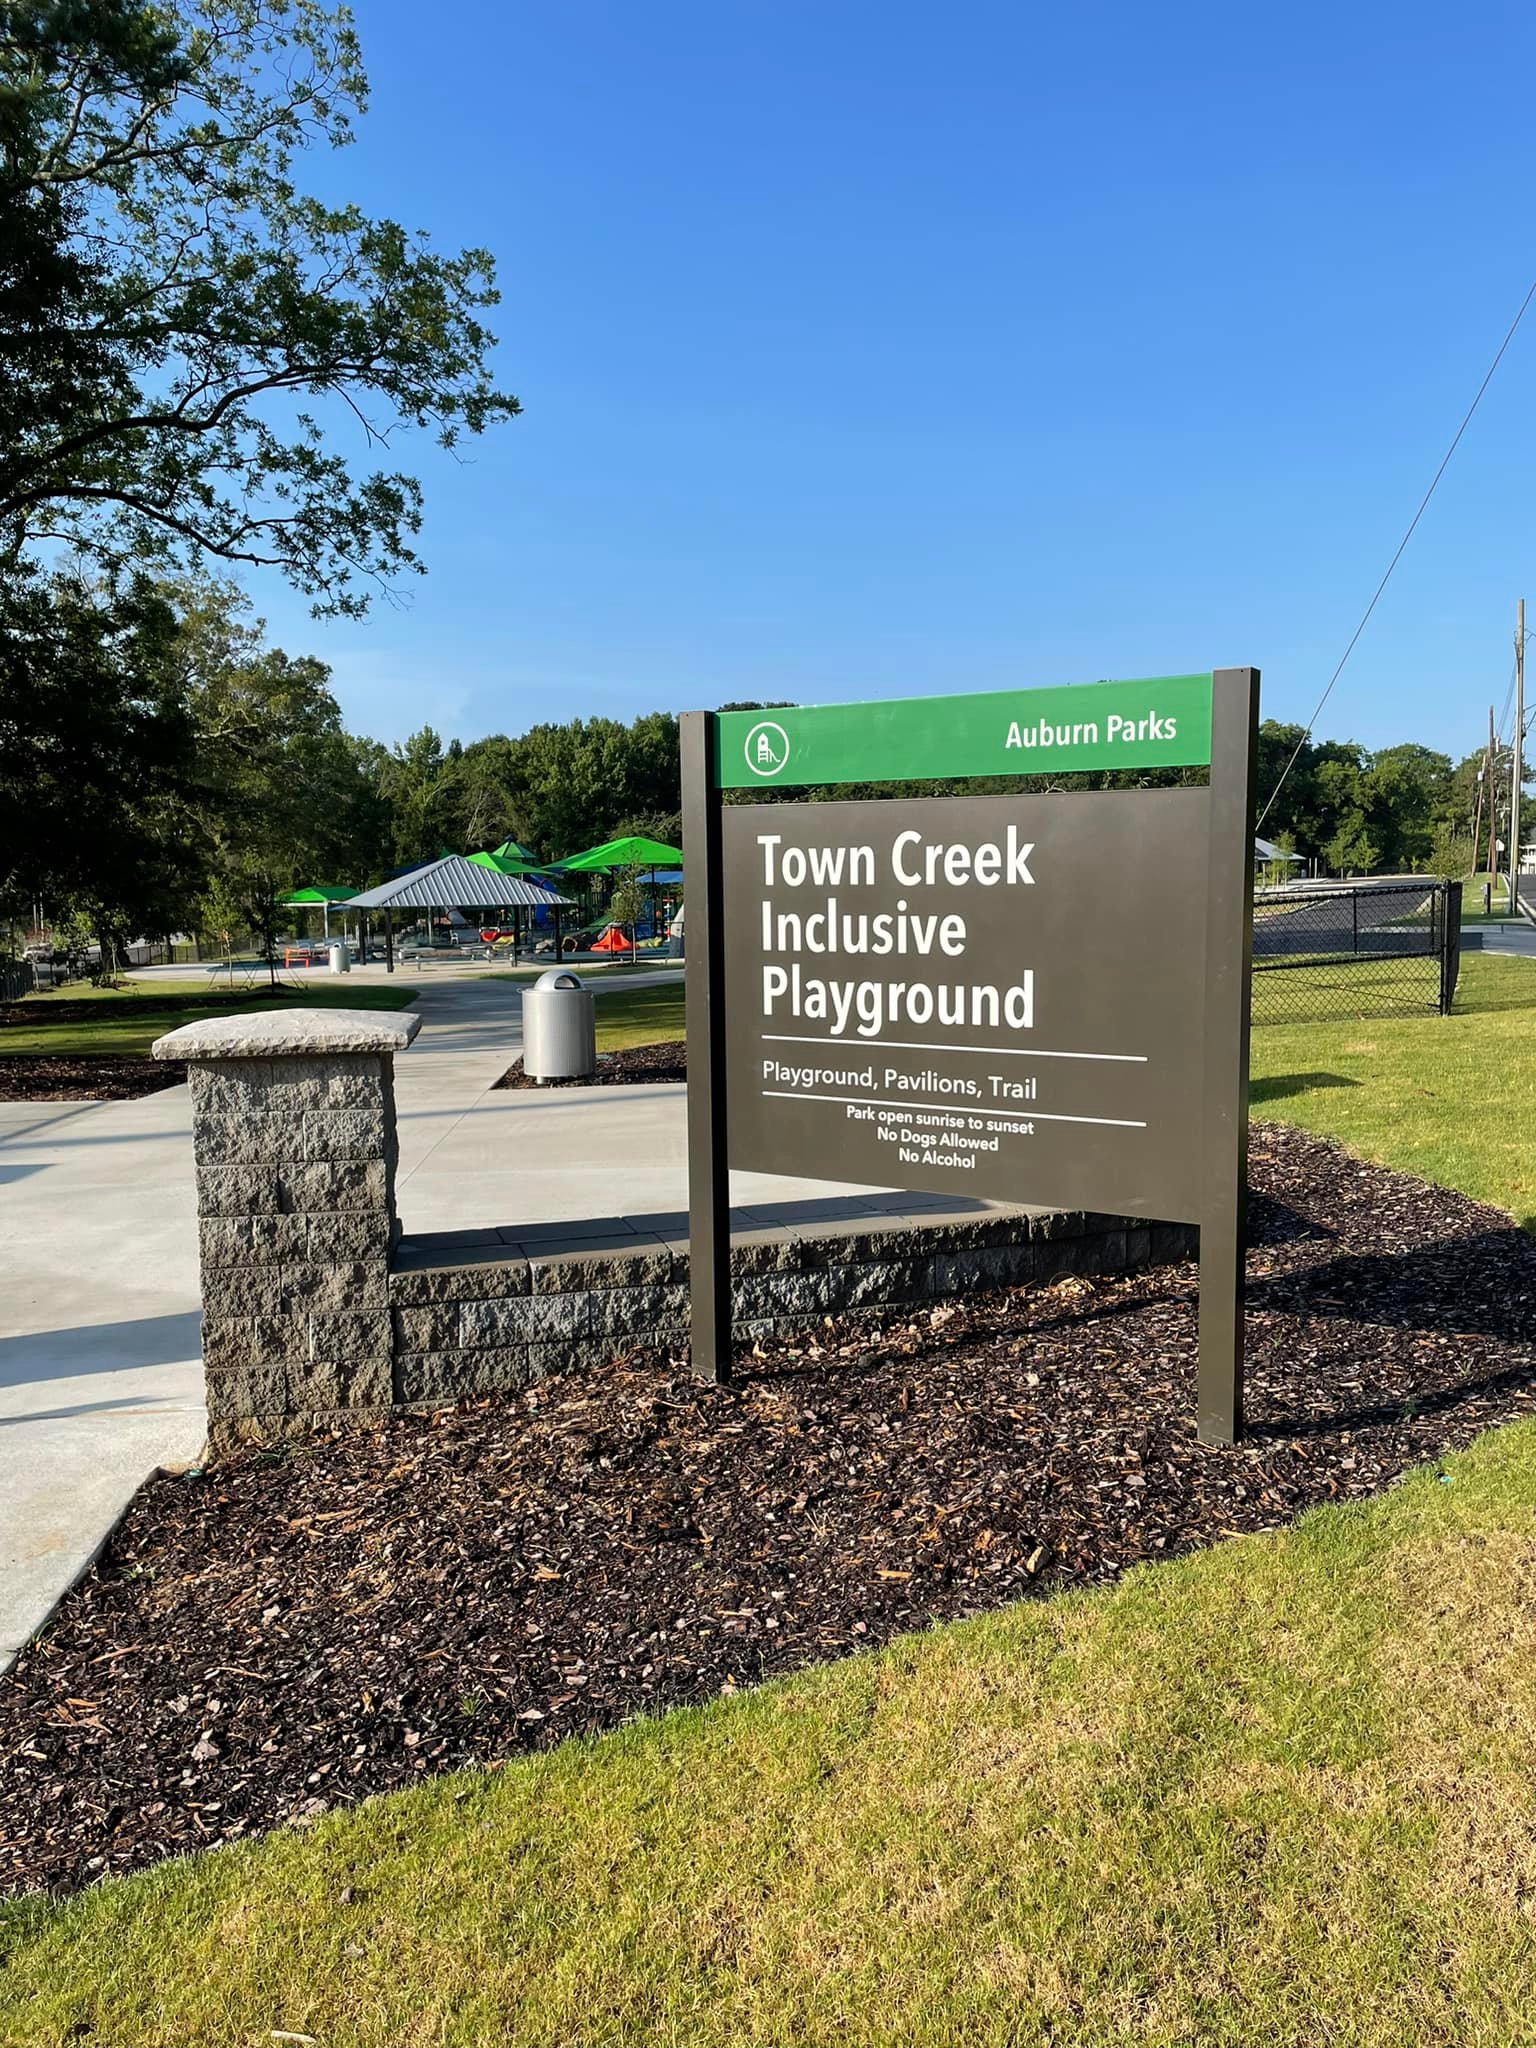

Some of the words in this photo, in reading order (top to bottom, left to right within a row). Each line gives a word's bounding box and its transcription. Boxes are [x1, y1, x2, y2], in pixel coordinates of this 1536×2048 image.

[1005, 717, 1098, 749] Auburn
[1106, 710, 1177, 743] Parks
[756, 834, 875, 887] Town
[891, 824, 1036, 887] Creek
[761, 897, 967, 957] Inclusive
[762, 963, 1034, 1037] Playground
[763, 1060, 879, 1091] Playground,
[884, 1068, 983, 1099] Pavilions,
[987, 1075, 1037, 1100] Trail
[846, 1104, 876, 1121] Park
[877, 1110, 913, 1126] open
[915, 1113, 966, 1129] sunrise
[967, 1116, 984, 1130] to
[986, 1120, 1035, 1135] sunset
[877, 1126, 898, 1142] No
[900, 1128, 938, 1149] Dogs
[938, 1132, 999, 1152] Allowed
[898, 1147, 920, 1163] No
[921, 1149, 976, 1169] Alcohol
